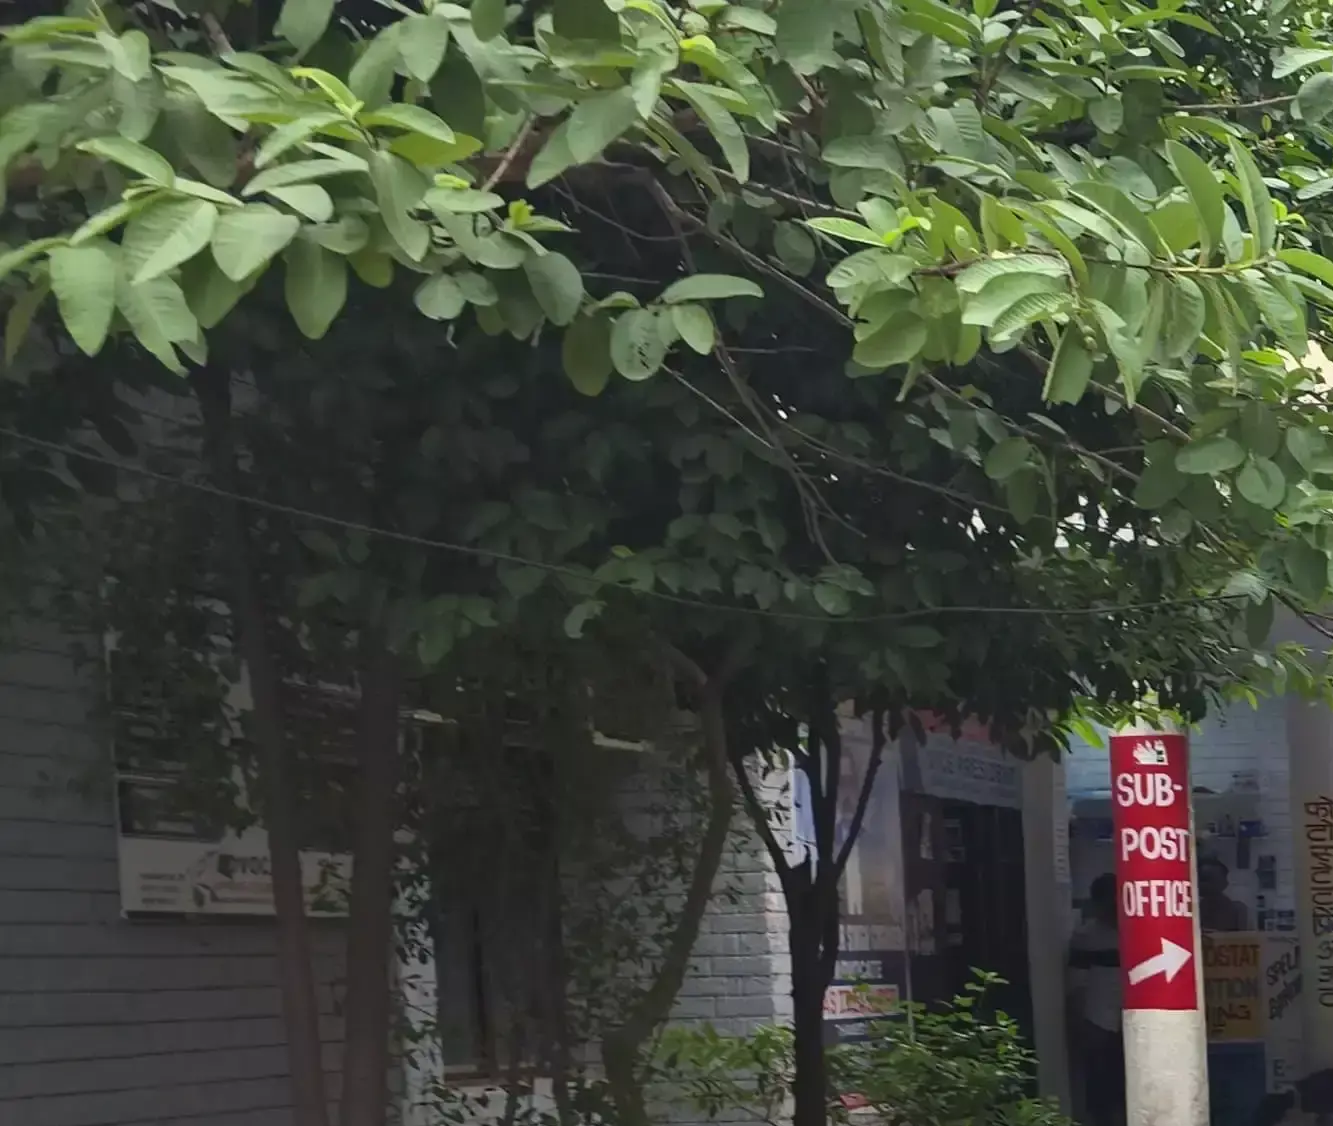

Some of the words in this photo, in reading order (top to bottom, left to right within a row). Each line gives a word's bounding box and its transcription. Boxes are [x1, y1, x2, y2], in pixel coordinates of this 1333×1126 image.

[1116, 773, 1184, 808] SUB-
[1120, 826, 1190, 862] POST
[1122, 879, 1193, 918] OFFICE
